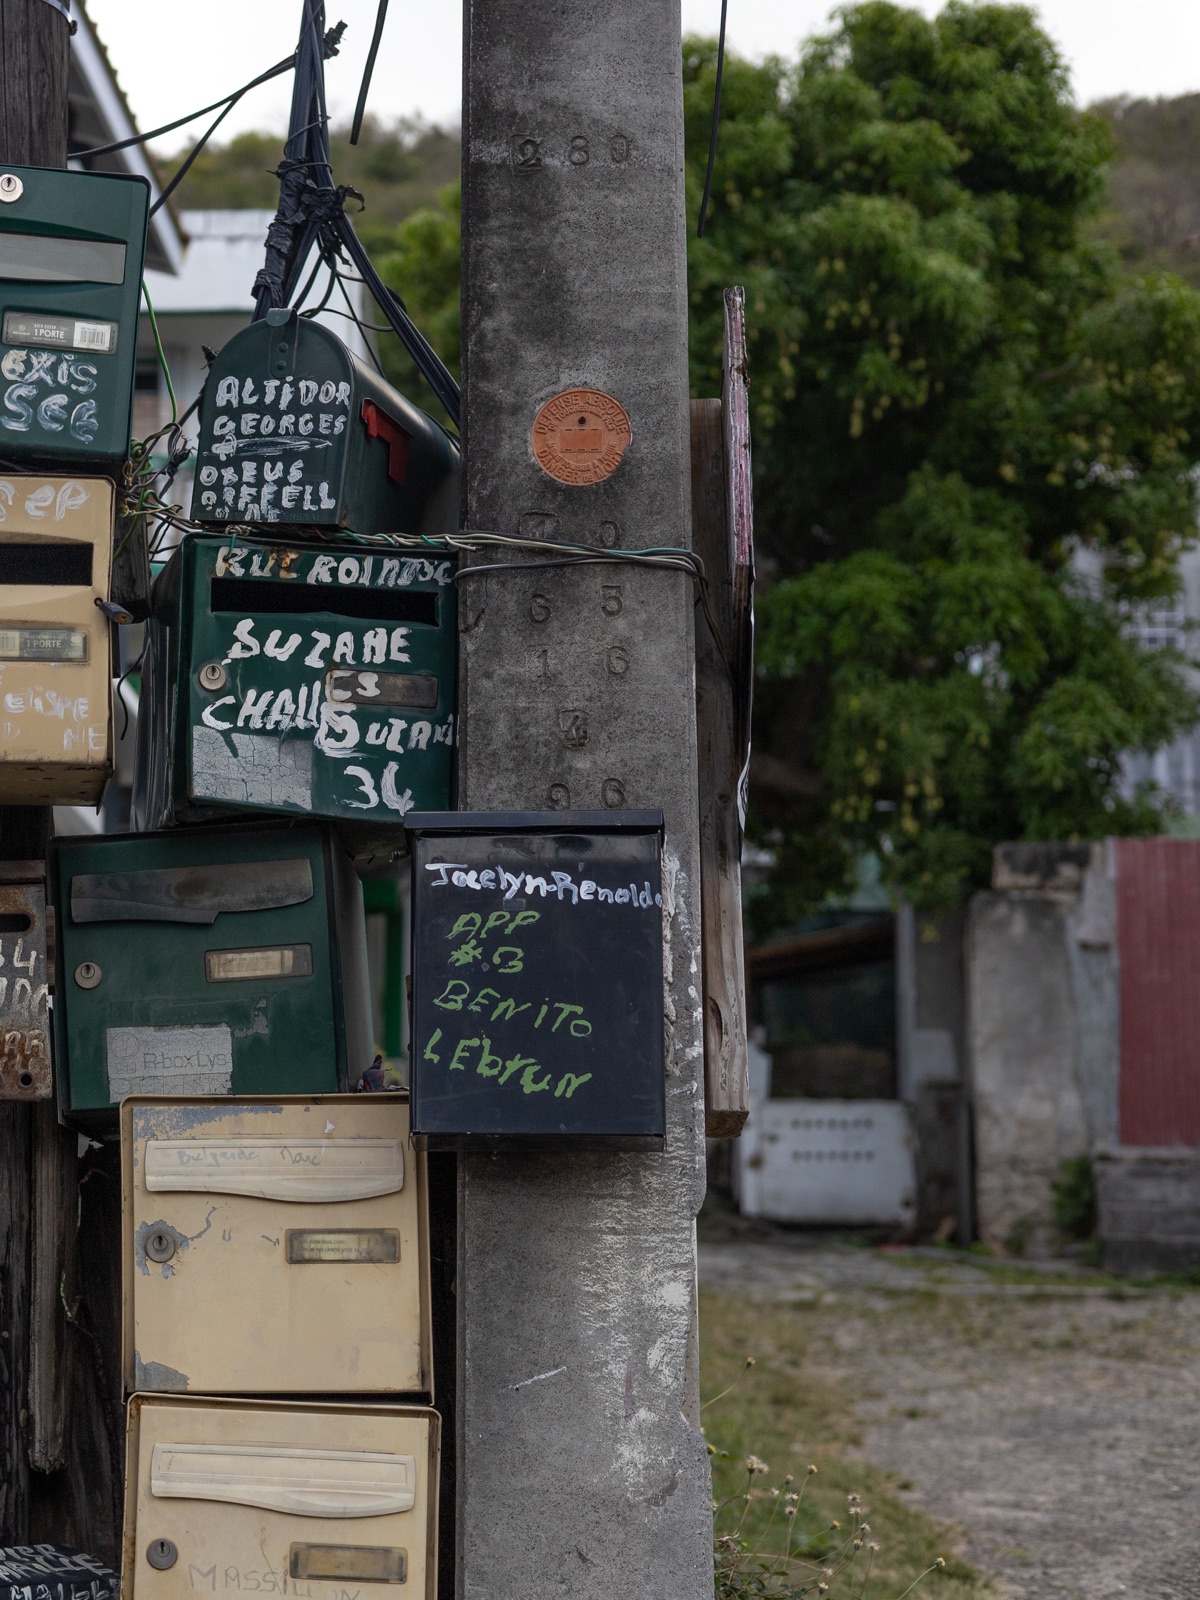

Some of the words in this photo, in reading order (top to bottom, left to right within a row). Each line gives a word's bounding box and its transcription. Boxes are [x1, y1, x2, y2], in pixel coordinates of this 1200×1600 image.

[39, 328, 65, 339] PORTE
[213, 413, 347, 436] GEORGES
[535, 394, 581, 436] DEFENSE
[584, 393, 630, 436] ABSOLUE
[537, 449, 580, 484] DANGER
[33, 640, 62, 648] PORTE
[445, 911, 541, 941] APP
[197, 1050, 228, 1072] Lys
